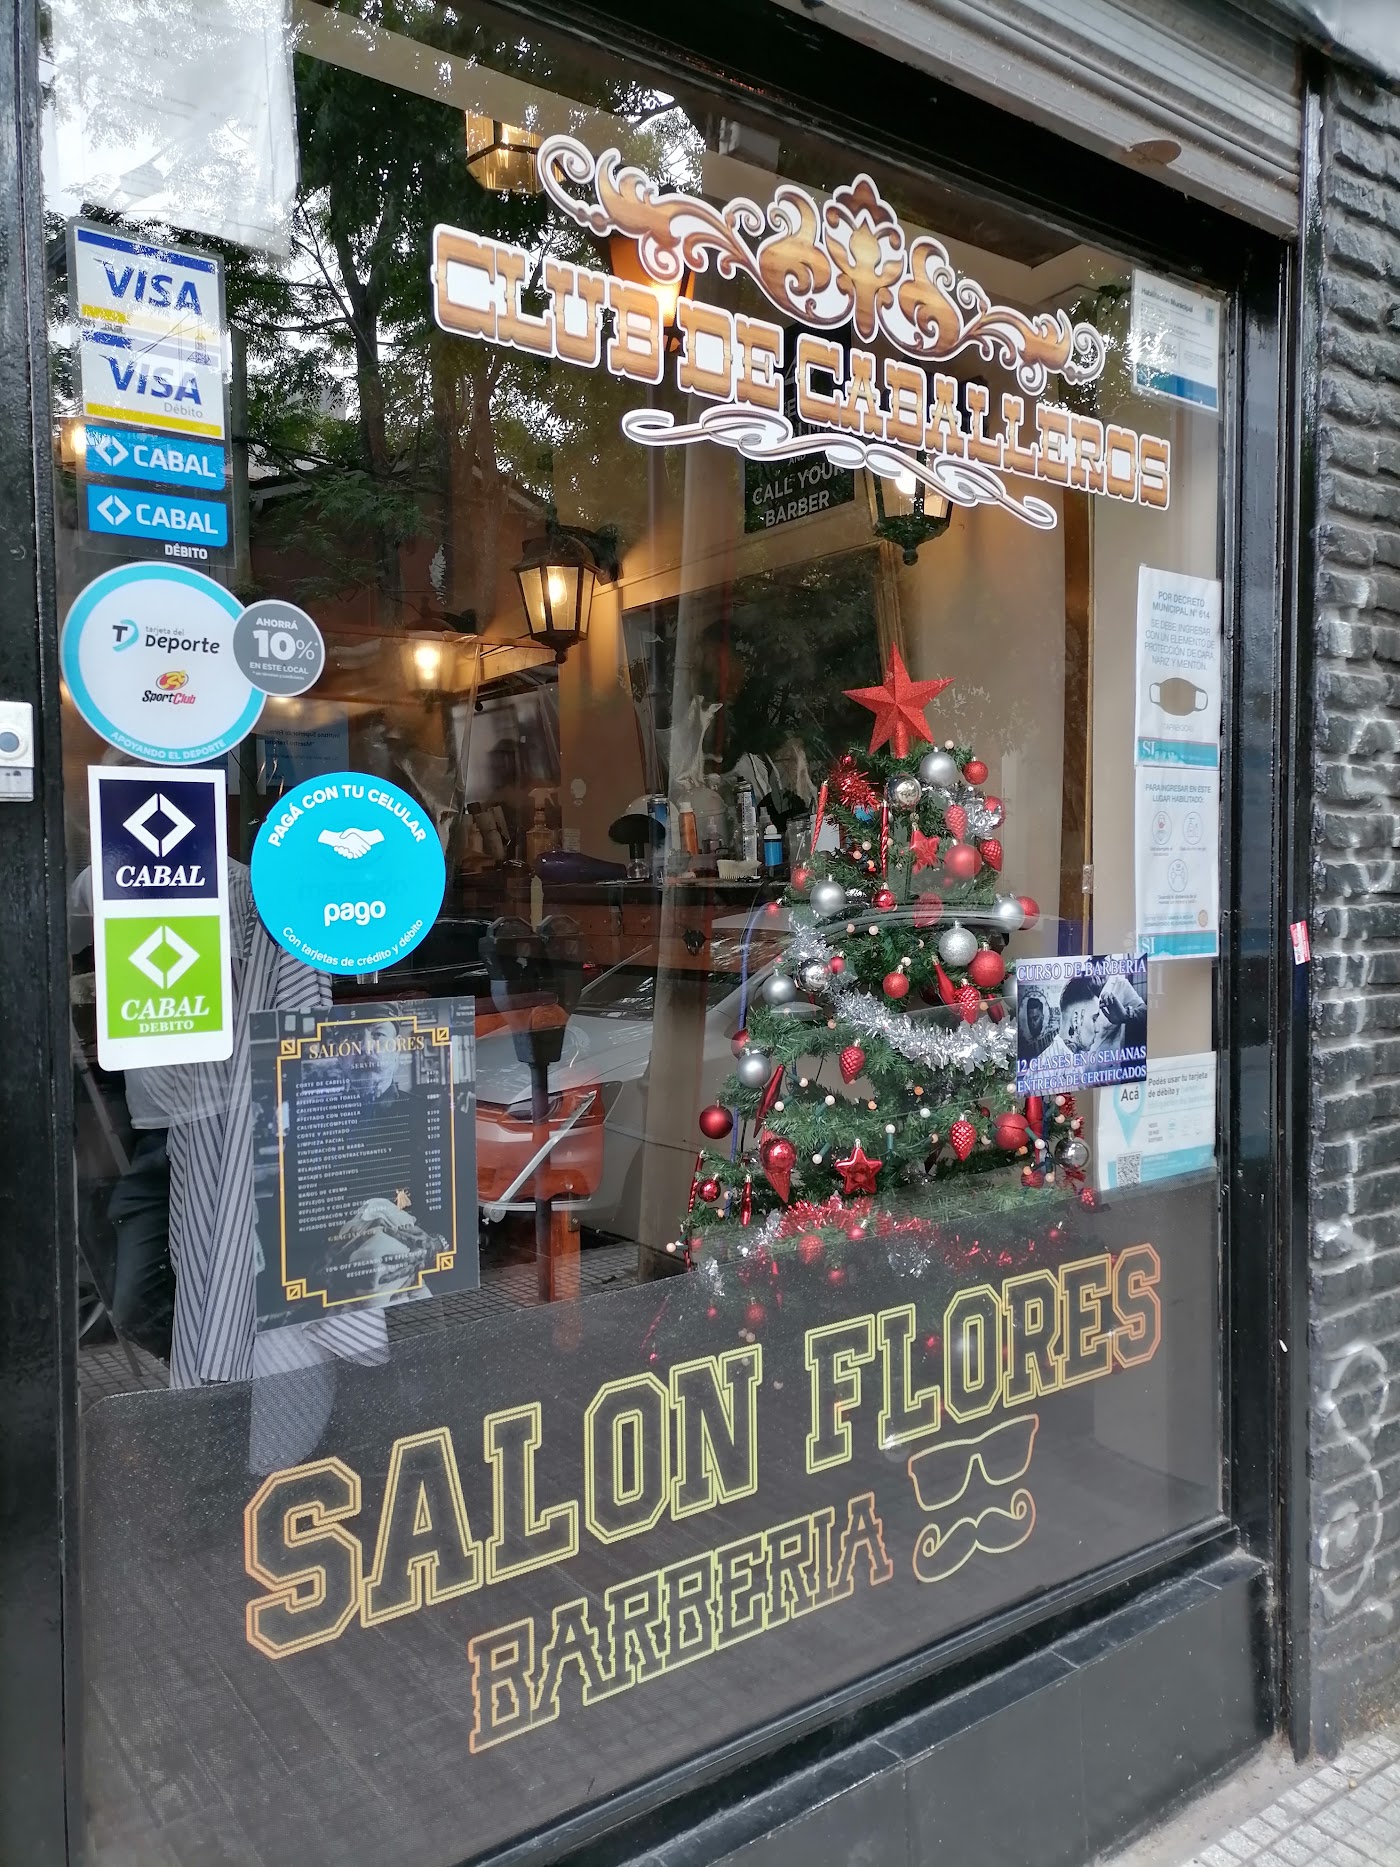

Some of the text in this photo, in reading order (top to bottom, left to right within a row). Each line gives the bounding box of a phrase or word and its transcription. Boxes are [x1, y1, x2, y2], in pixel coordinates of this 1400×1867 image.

[93, 257, 203, 316] VISA
[430, 222, 1171, 512] CLUB DE CABALLEROS
[98, 353, 203, 405] VISA
[164, 401, 204, 419] Débito
[133, 445, 217, 478] CABAL
[752, 475, 793, 506] CALL
[764, 489, 830, 528] BARBER
[136, 503, 219, 535] CABAL
[164, 543, 209, 560] DÉBITO
[1158, 591, 1205, 608] POR DECRETO
[1152, 601, 1189, 616] MUNICIPAL
[1198, 610, 1210, 619] 614
[145, 625, 185, 636] tarjeta del
[256, 617, 299, 630] AHORRÁ
[1151, 619, 1211, 637] SE DEBE INGRESAR
[145, 634, 220, 654] Deporte
[1145, 630, 1215, 650] CON UN ELEMENTO DE
[1144, 642, 1186, 656] PROTECCIÓN
[1187, 648, 1196, 658] DE
[249, 661, 261, 669] EN
[262, 663, 282, 672] ESTE
[283, 665, 309, 675] LOCAL
[142, 689, 196, 705] SportClub
[110, 731, 226, 760] APOYANDO EL DEPORTE
[1145, 783, 1211, 793] PARA INGRESAR EN ESTE
[1152, 795, 1171, 803] LUGAR
[267, 784, 427, 848] PAGÁ CON TU CELULAR
[115, 865, 206, 887] CABAL
[323, 900, 387, 927] pago
[282, 919, 423, 967] Con tarjetas de crédito y débito
[1016, 958, 1147, 981] CURSO DE BARBERIA
[120, 996, 210, 1021] CABAL
[138, 1019, 195, 1034] DEBITO
[309, 1035, 425, 1059] SALÓN FLORES
[1016, 1045, 1147, 1073] 12 CLASES EN 6 SEMANAS
[296, 1081, 314, 1089] CORTE
[325, 1078, 350, 1086] CABELLO
[1017, 1065, 1147, 1093] ENTREGA DE CERTIFICADOS
[1148, 1071, 1208, 1087] Podés usar tu tarjeta
[1120, 1086, 1139, 1102] Acá
[1148, 1090, 1155, 1098] de
[1156, 1087, 1175, 1097] débito
[1175, 1088, 1180, 1096] y
[296, 1098, 325, 1106] AFEITADO
[296, 1114, 325, 1123] AFEITADO
[297, 1131, 315, 1139] CORTE
[322, 1128, 350, 1136] AFEITADO
[297, 1140, 324, 1148] LIMPIEZA
[325, 1137, 344, 1145] FACIAL
[346, 1142, 365, 1150] BARBA
[297, 1156, 322, 1165] MASAJES
[323, 1148, 387, 1162] DESCONTRACTURANTES
[297, 1163, 332, 1173] RELAJANTES
[297, 1168, 359, 1182] MASAJES DEPORTIVOS
[328, 1186, 348, 1194] CREMA
[298, 1195, 345, 1207] REFLEJOS DESDE
[298, 1206, 325, 1215] REFLEJOS
[332, 1202, 351, 1210] COLOR
[352, 1199, 369, 1207] DESD
[339, 1263, 352, 1271] OFF
[353, 1257, 384, 1268] PAGANDO
[244, 1242, 1161, 1660] SALON FLORES
[468, 1490, 895, 1754] BARBERIA
